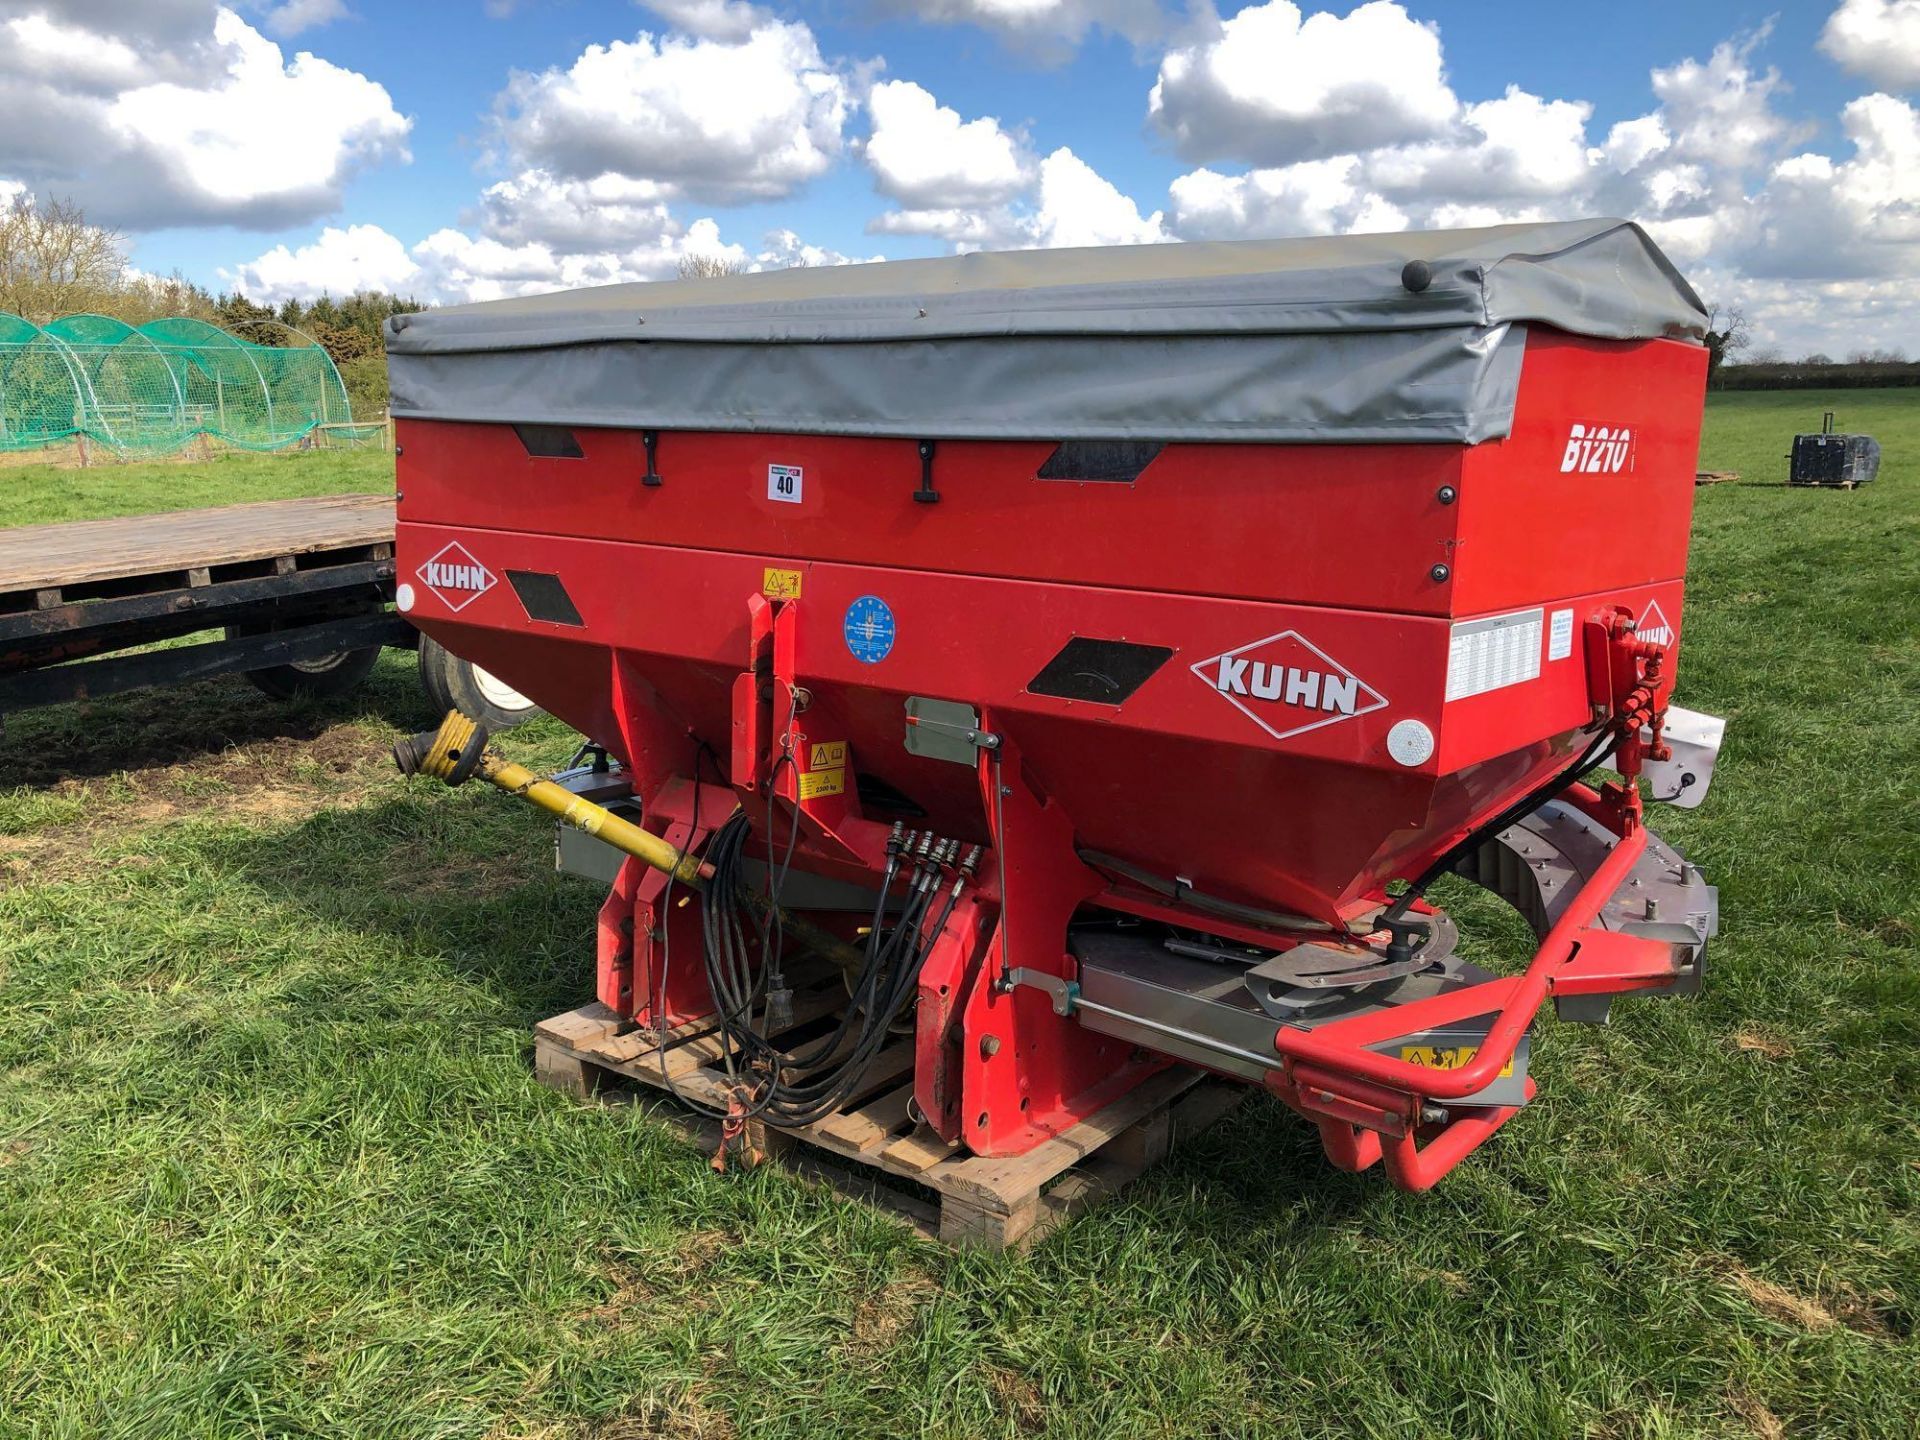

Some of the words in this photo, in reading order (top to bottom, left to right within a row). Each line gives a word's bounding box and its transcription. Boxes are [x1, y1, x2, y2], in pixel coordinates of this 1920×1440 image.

[1560, 424, 1631, 473] B1210
[777, 475, 794, 495] 40
[426, 561, 486, 592] KUHN
[1216, 655, 1359, 716] KUHN
